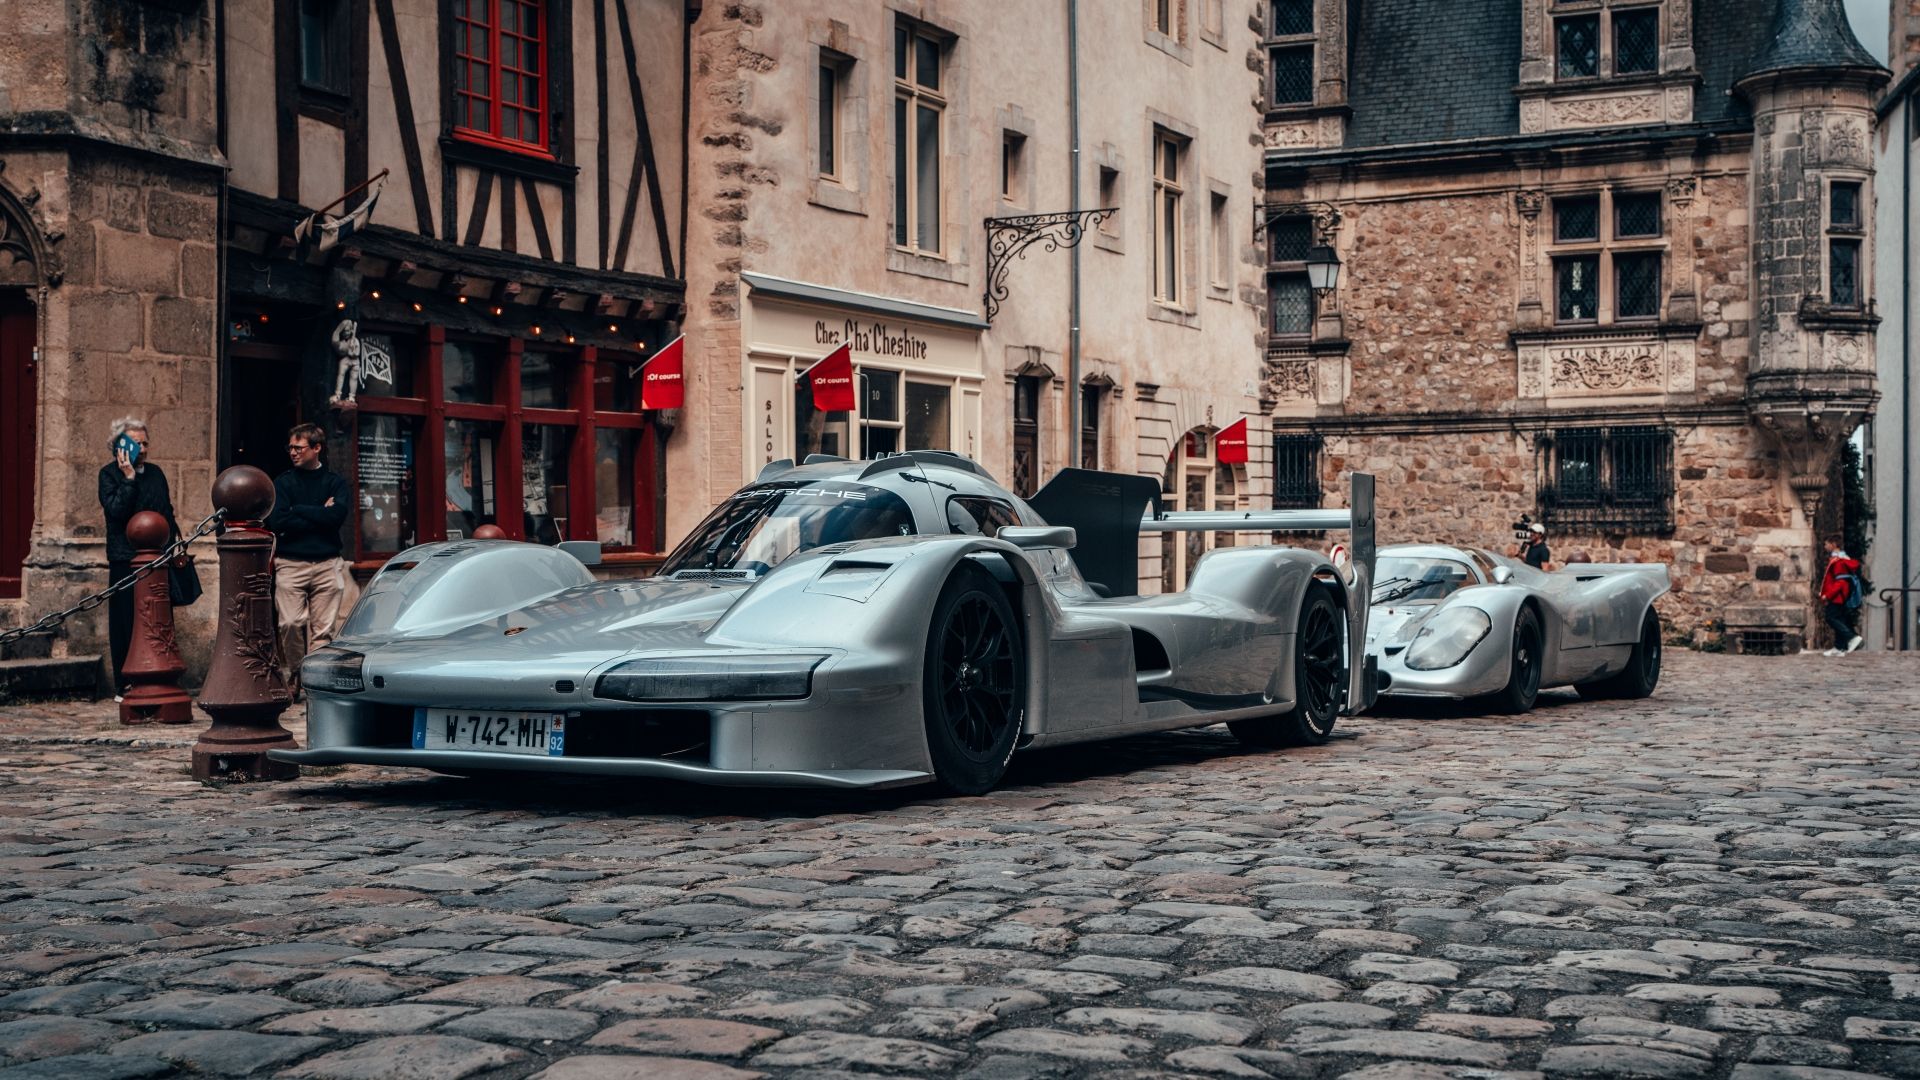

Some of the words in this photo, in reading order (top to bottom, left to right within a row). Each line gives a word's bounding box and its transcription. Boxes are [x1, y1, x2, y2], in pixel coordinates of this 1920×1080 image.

[815, 320, 839, 345] Chez
[844, 318, 928, 360] Cha'Cheshire
[827, 377, 849, 385] course
[733, 487, 866, 501] ORSCHE
[416, 732, 422, 741] F
[550, 736, 563, 751] 92
